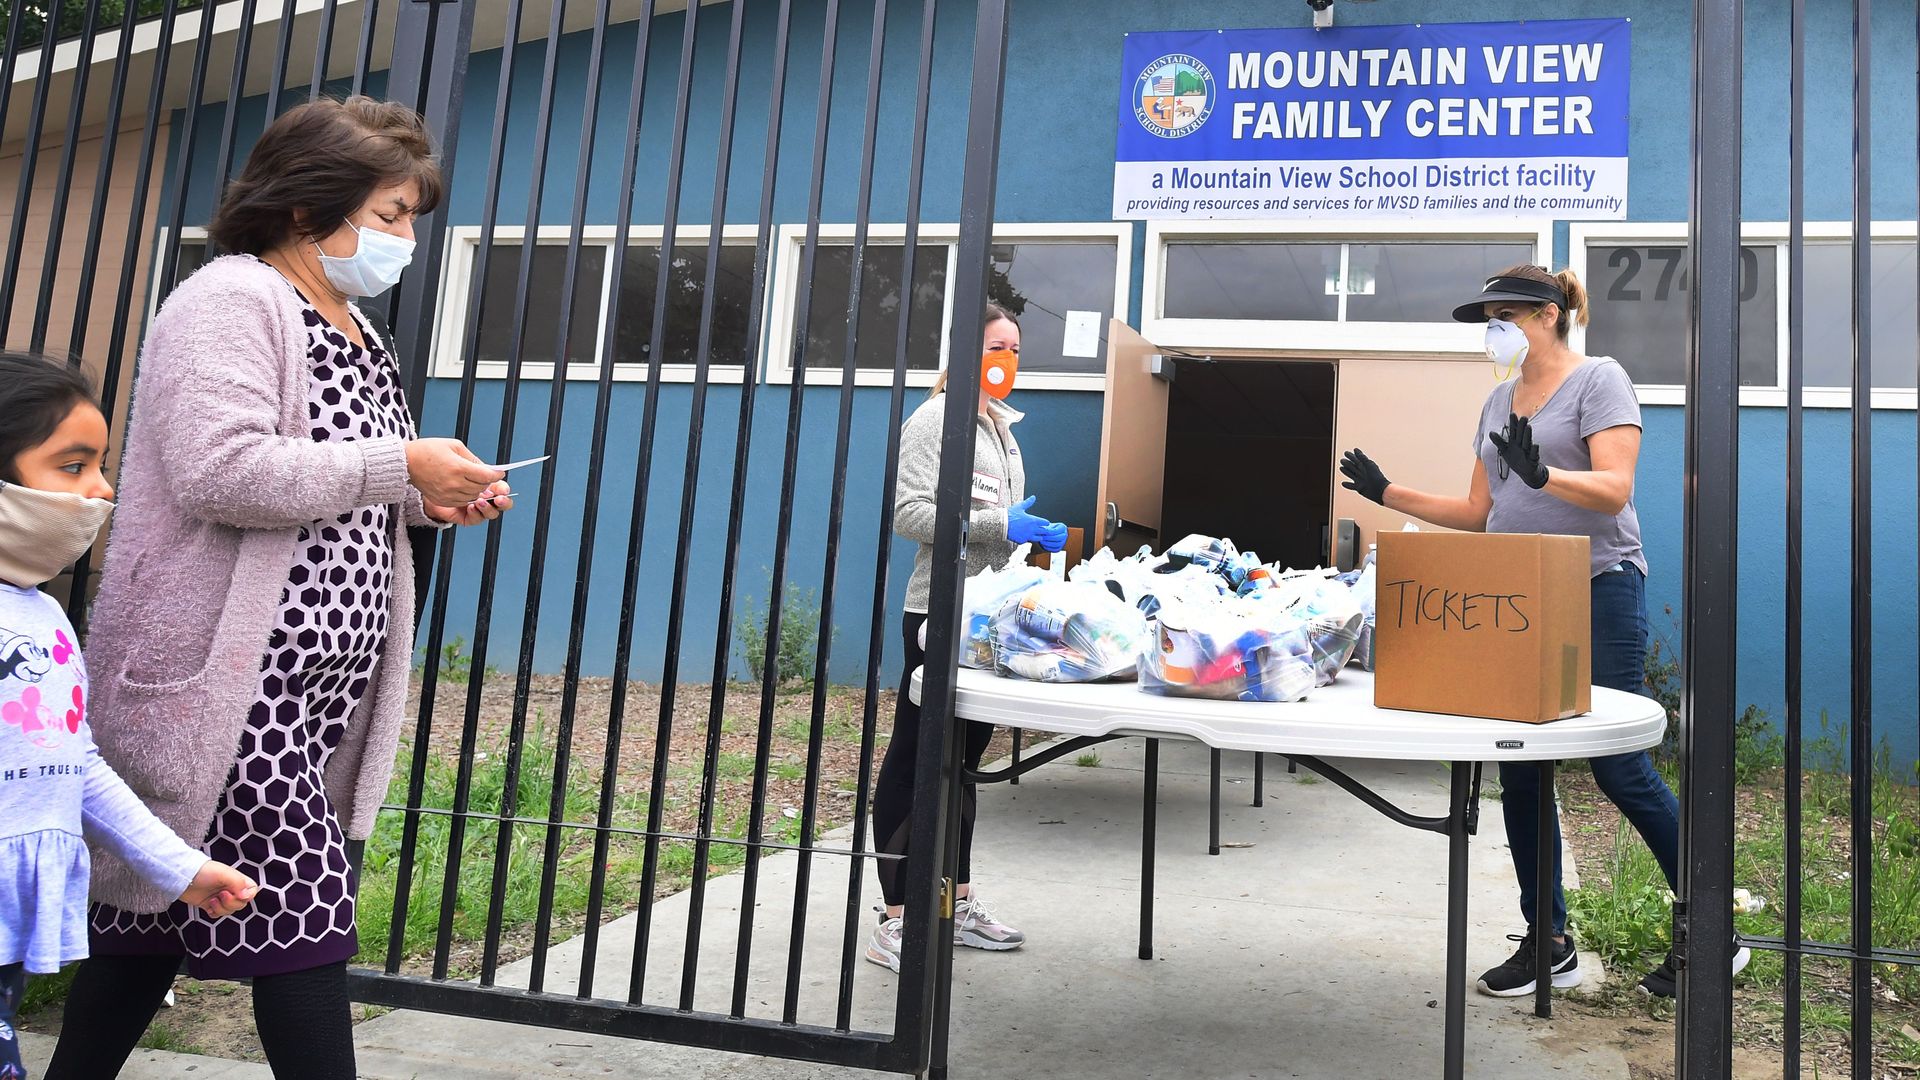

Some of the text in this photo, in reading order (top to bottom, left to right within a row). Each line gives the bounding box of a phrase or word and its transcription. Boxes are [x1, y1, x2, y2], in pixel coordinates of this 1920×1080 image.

[1140, 56, 1213, 82] MOUNTAIN VIEW
[1228, 43, 1604, 89] MOUNTAIN VIEW
[1136, 106, 1211, 137] SCHOOL DISTRICT
[1232, 96, 1594, 139] FAMILY CENTER
[1152, 163, 1596, 192] a Mountain View School District facility
[1127, 195, 1623, 213] providing resources and services for MVSD families and the community
[1385, 579, 1530, 632] TICKETS
[39, 765, 70, 776] TRUE
